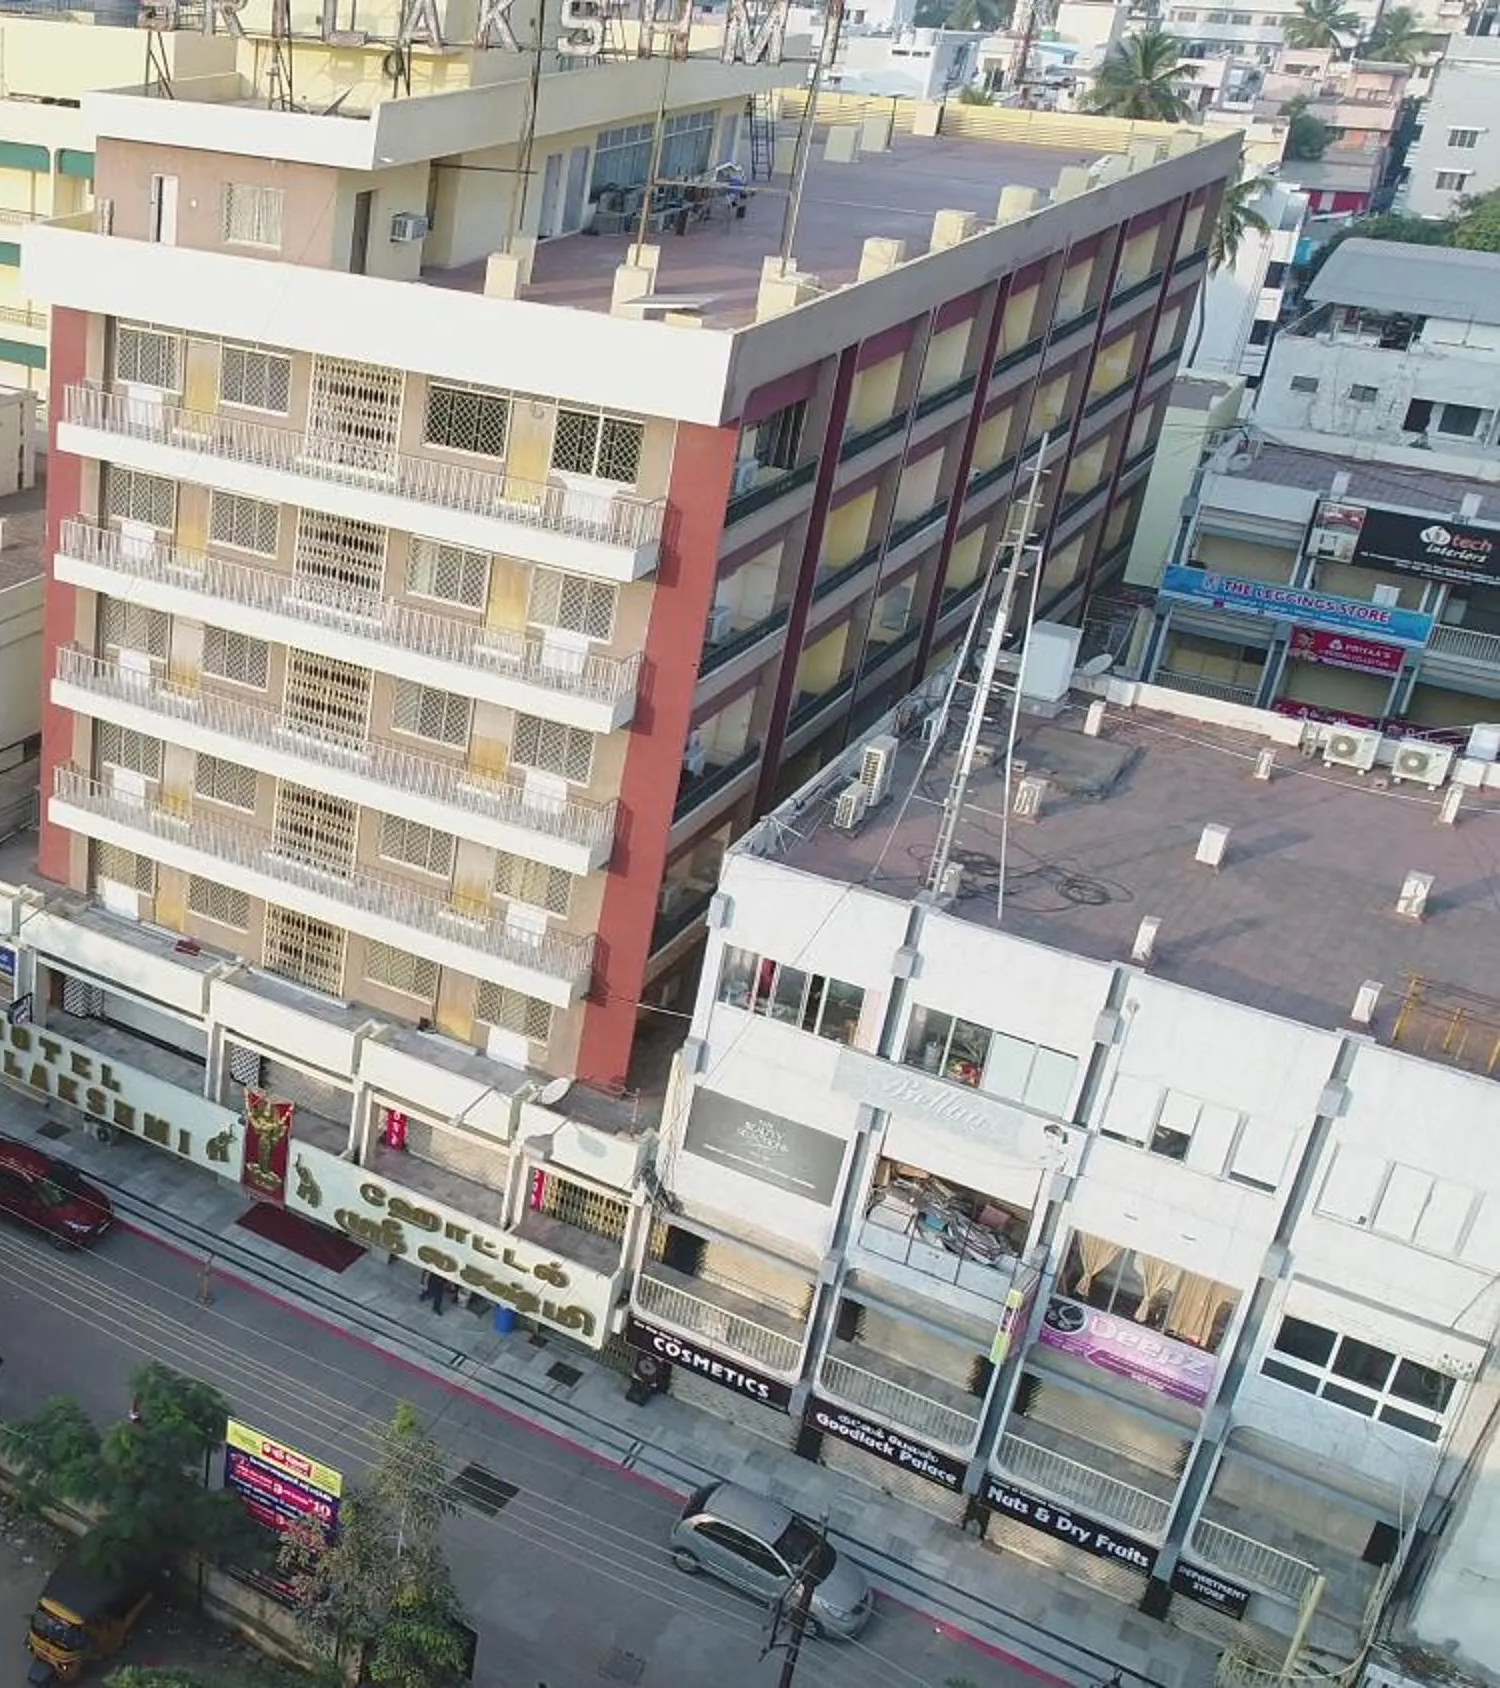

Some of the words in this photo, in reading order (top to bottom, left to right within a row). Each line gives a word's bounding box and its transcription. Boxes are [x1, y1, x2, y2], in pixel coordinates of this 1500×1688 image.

[1222, 580, 1252, 598] THE
[1339, 602, 1391, 624] STORE
[3, 1049, 191, 1156] LAKSHMI
[653, 1336, 770, 1399] COSMETICS
[899, 1449, 958, 1485] Palace
[1034, 1507, 1051, 1525] &
[1055, 1513, 1092, 1544] Dry
[1192, 1581, 1226, 1601] STORE
